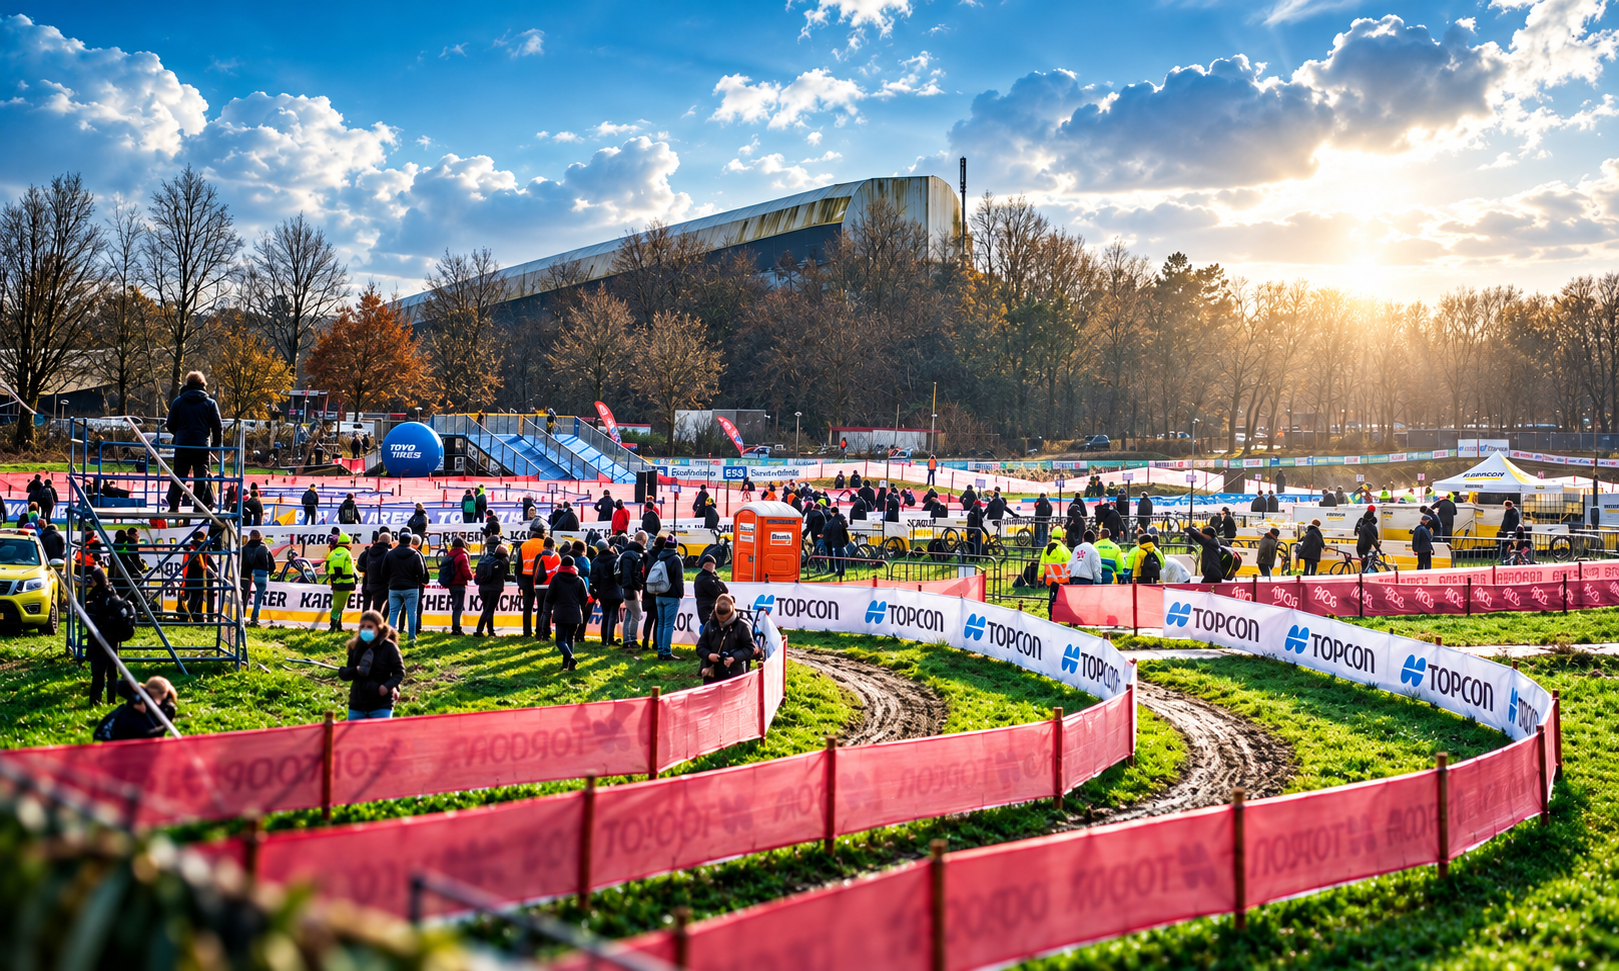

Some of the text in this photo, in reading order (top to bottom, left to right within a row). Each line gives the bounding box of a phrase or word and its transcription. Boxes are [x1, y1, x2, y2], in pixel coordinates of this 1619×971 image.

[776, 598, 839, 620] TOPCON
[888, 605, 944, 632] TOPCON
[987, 622, 1041, 660] TOPCON
[1193, 608, 1259, 642] TOPCON
[1311, 633, 1375, 674] TOPCON
[1428, 664, 1493, 712] TOPCON
